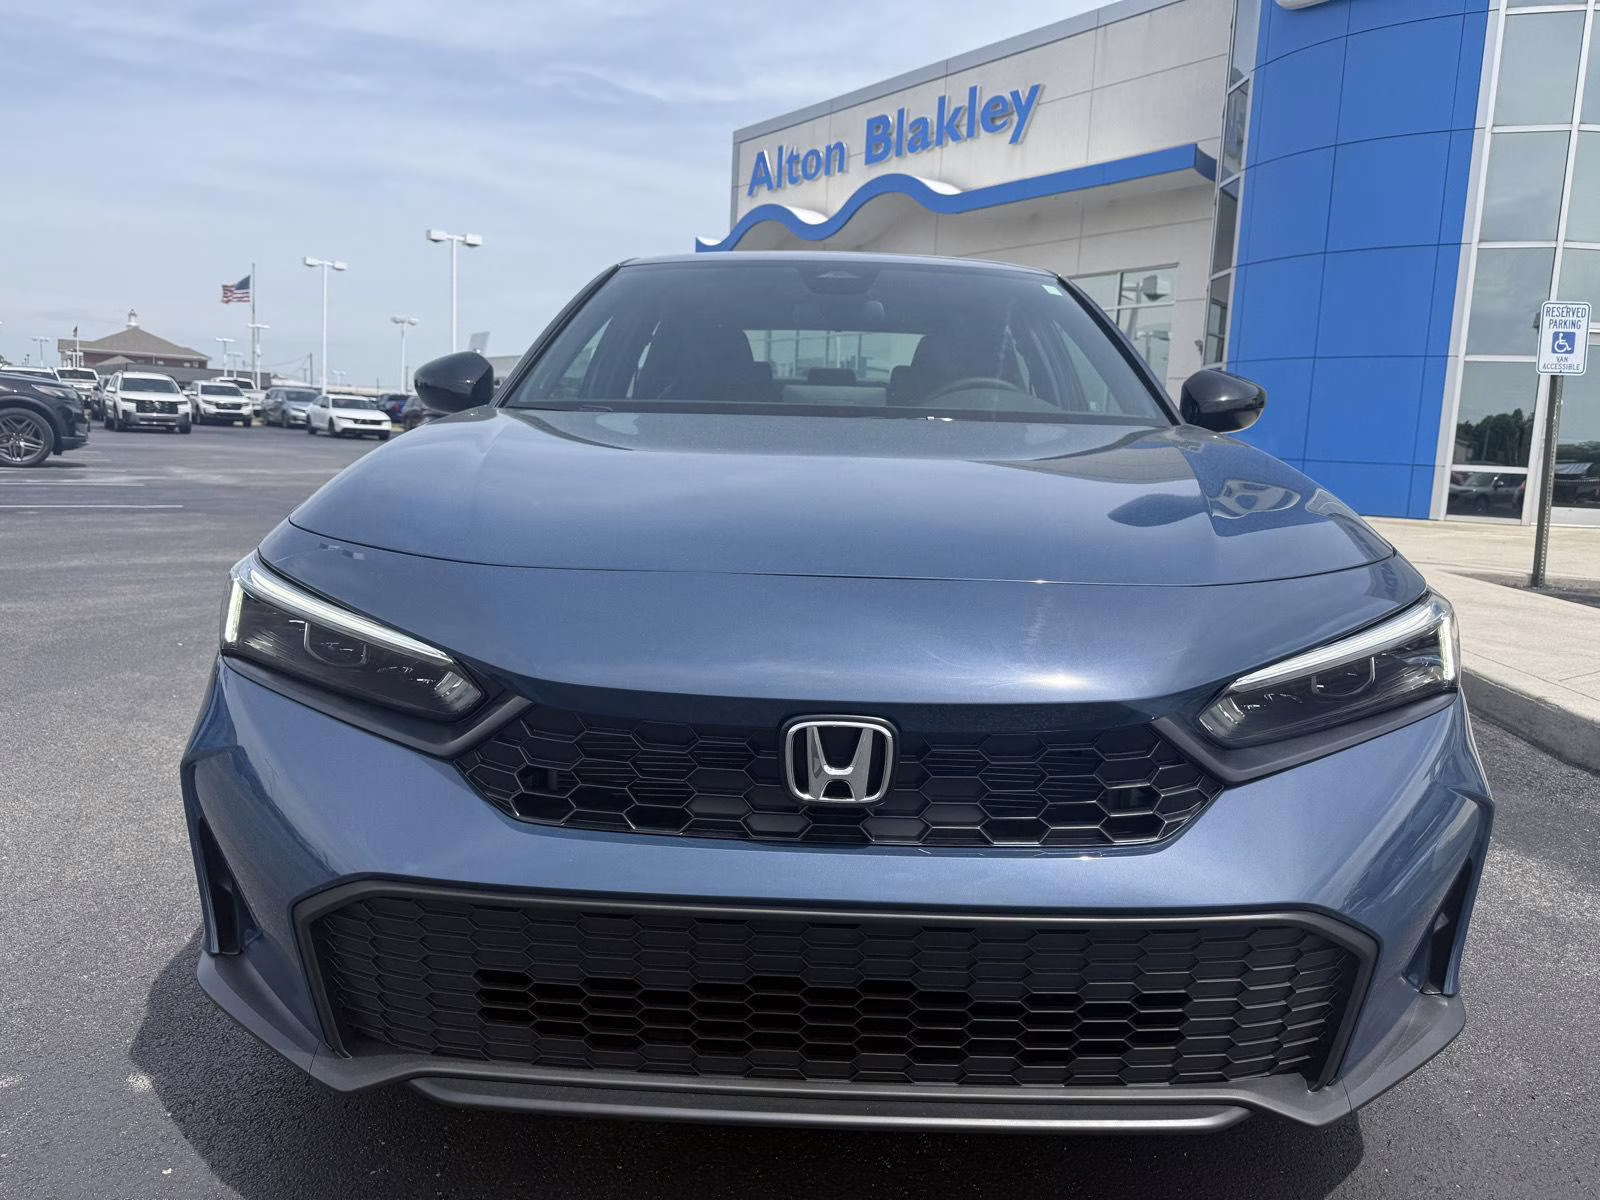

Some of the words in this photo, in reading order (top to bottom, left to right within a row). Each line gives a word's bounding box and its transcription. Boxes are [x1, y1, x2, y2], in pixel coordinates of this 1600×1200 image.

[747, 139, 848, 196] Alton
[864, 83, 1045, 166] Blakley
[1545, 306, 1586, 318] RESERVED
[1548, 319, 1581, 330] PARKING
